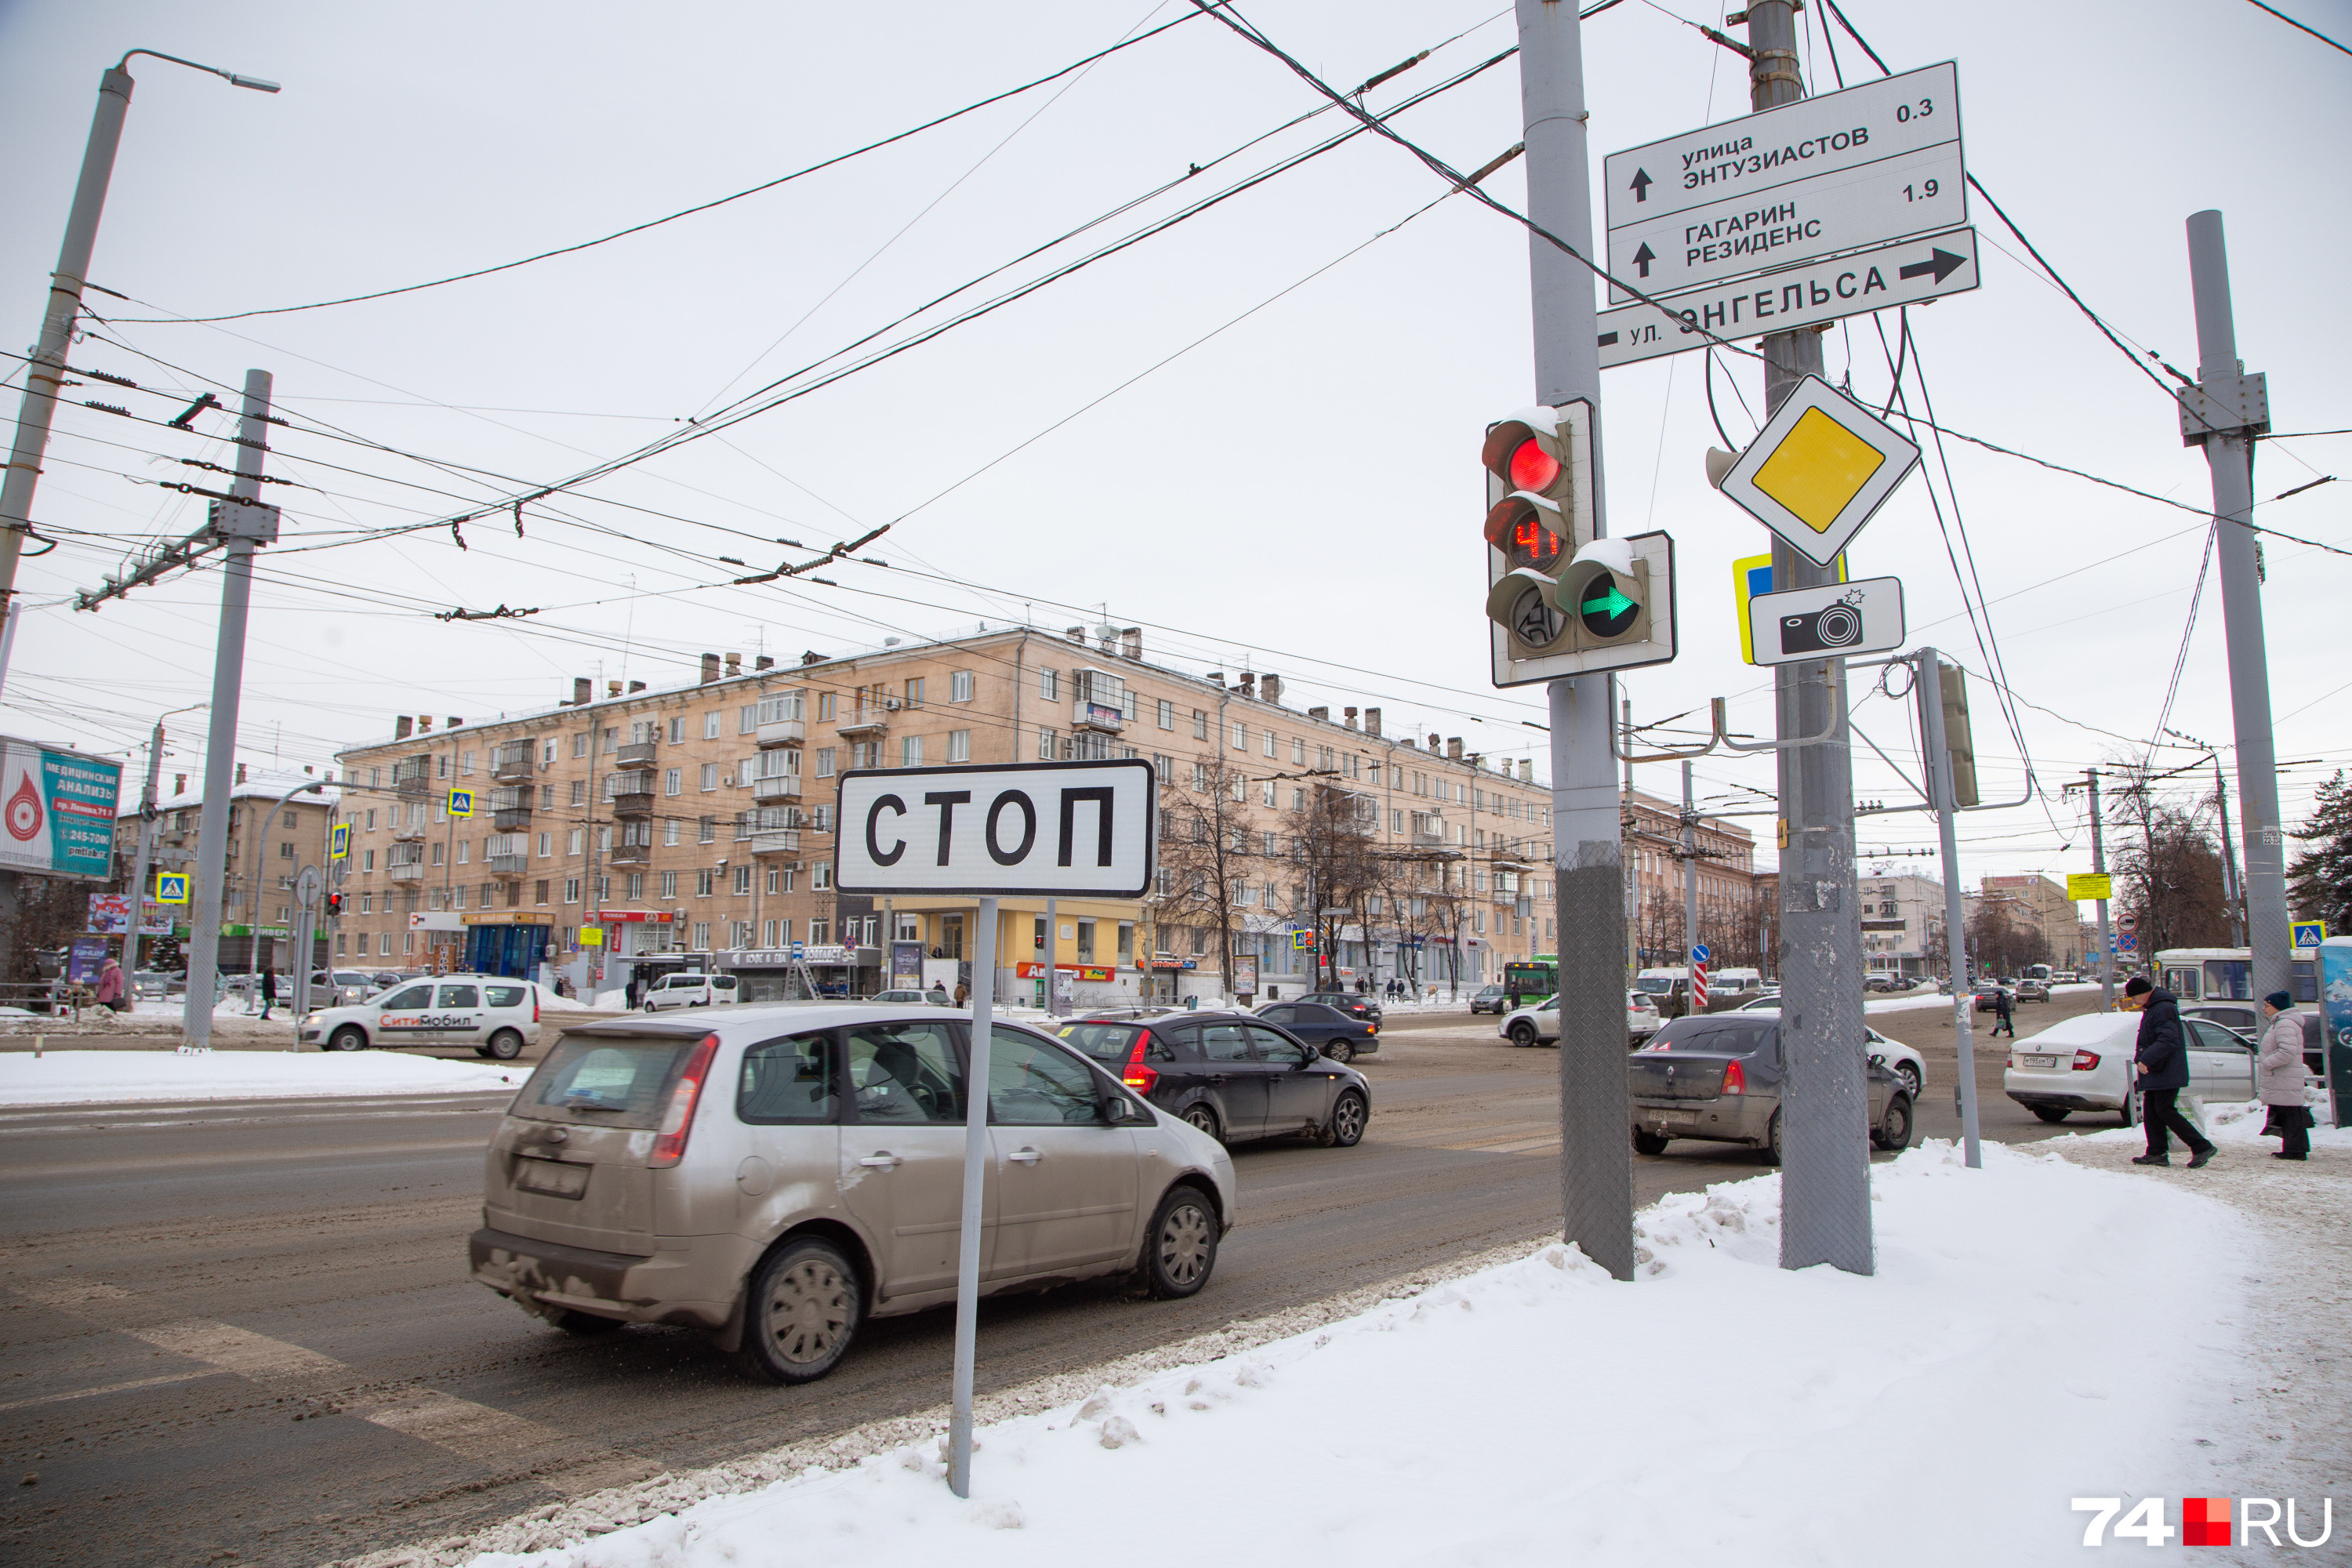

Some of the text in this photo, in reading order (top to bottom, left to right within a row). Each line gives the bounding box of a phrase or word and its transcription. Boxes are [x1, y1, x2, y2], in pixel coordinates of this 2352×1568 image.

[1896, 99, 1933, 123] 0.3
[1682, 136, 1752, 171] улица
[1682, 127, 1870, 191] ЭНТУЗИАСТОВ
[1902, 179, 1940, 203] 1.9
[1685, 201, 1796, 245] ГАГАРИН
[1686, 219, 1821, 267] РЕЗИДЕНС
[1679, 266, 1887, 335] ЭНГЕЛЬСА
[45, 761, 117, 785] МЕДИЦИНСКИЕ
[56, 779, 115, 800] АНАЛИЗЫ
[70, 830, 111, 845] 245-7000
[866, 786, 1114, 867] СТОП
[379, 1014, 471, 1026] Ситимобил
